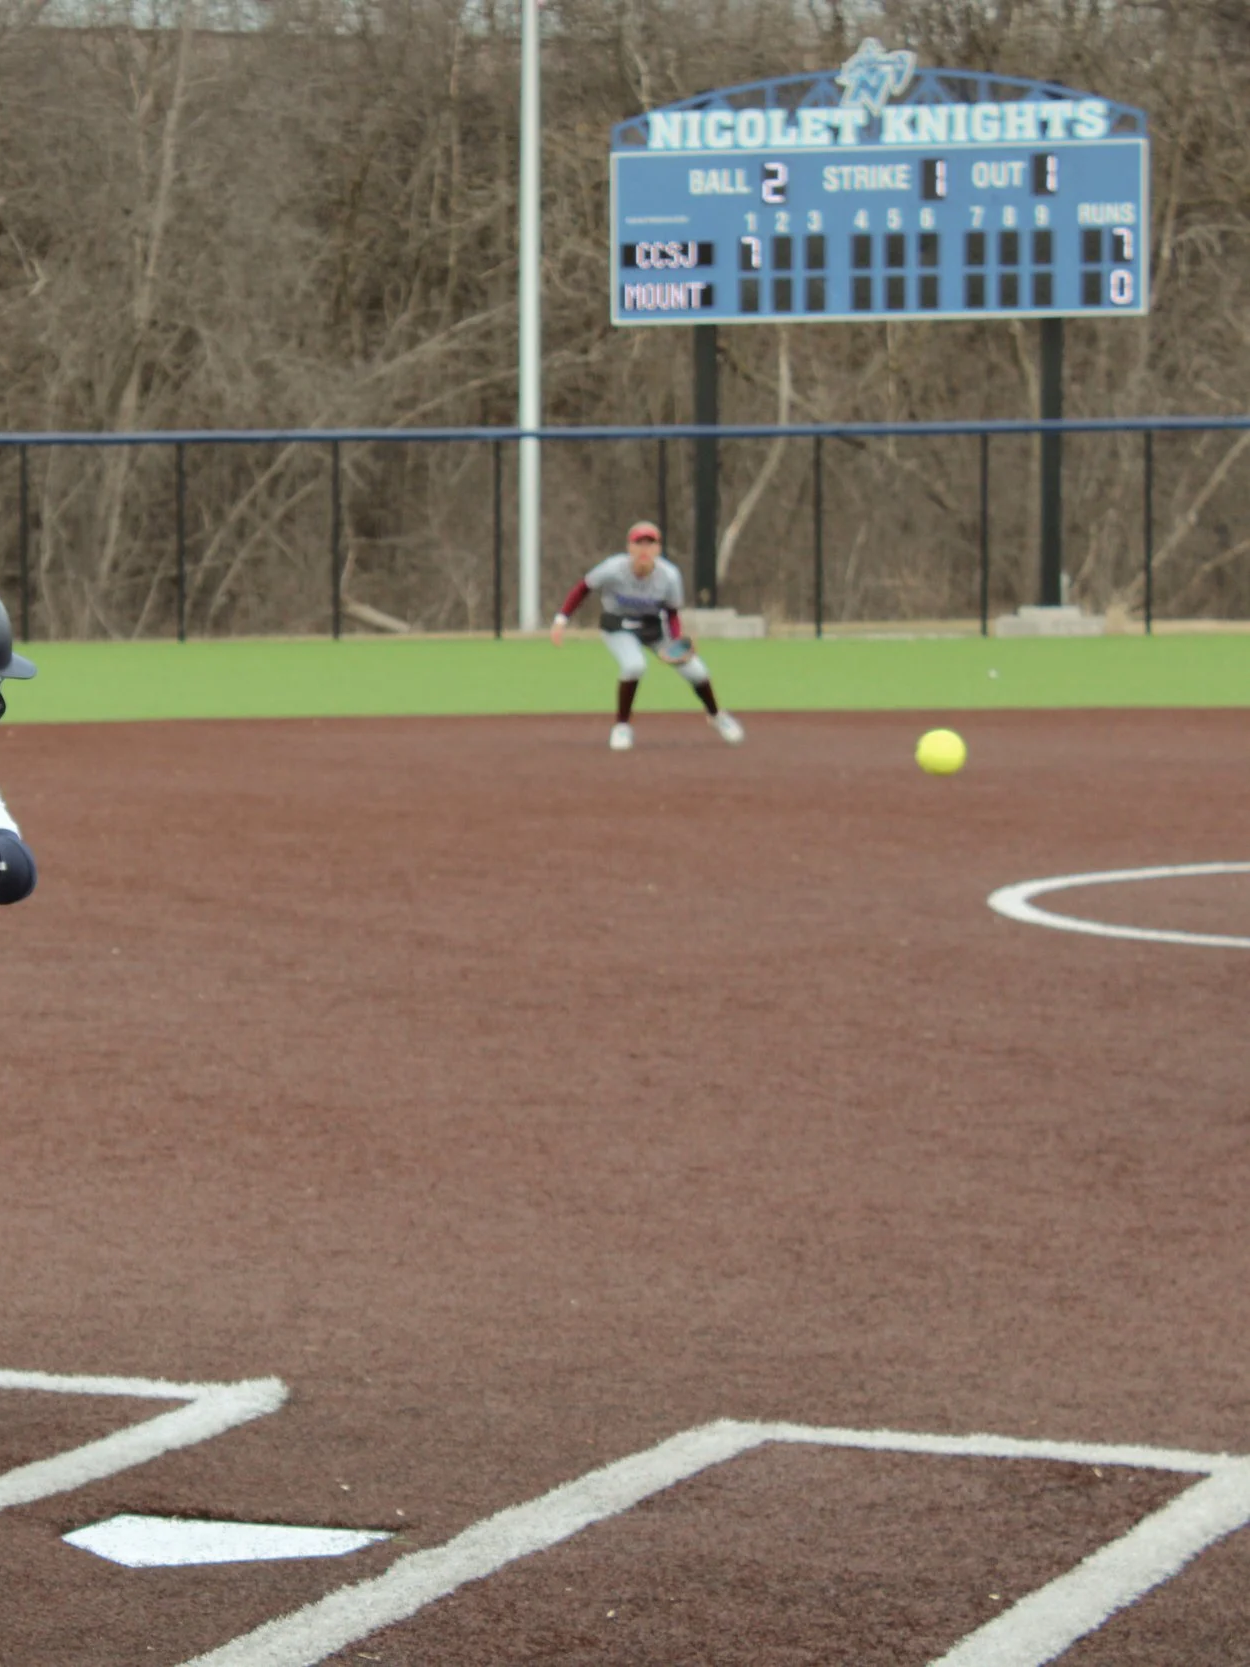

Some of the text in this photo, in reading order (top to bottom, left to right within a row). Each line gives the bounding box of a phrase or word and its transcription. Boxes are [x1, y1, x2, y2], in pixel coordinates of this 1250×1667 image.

[648, 100, 1108, 149] NICOLET KNIGHTS
[689, 162, 788, 203] BALL 2
[822, 160, 946, 197] STRIKE 1
[972, 155, 1058, 191] OUT 1
[744, 203, 1135, 233] 1 2 3 4 5 6 7 8 9 RUNS
[636, 227, 1133, 269] CCSJ 7 7
[624, 269, 1133, 310] MOUNT 0
